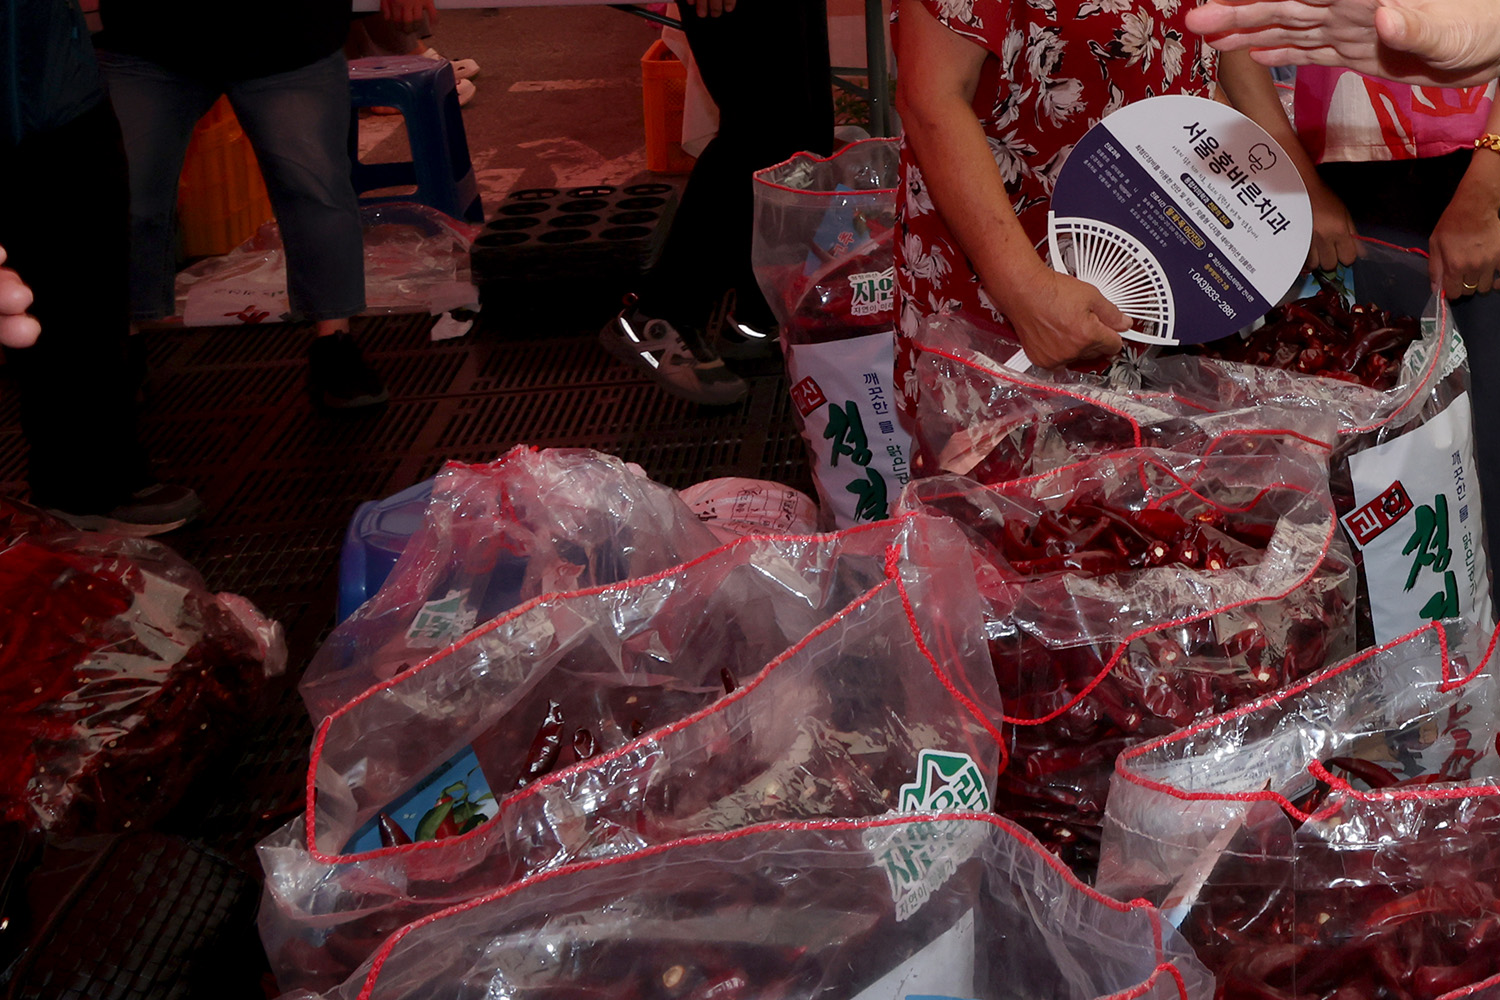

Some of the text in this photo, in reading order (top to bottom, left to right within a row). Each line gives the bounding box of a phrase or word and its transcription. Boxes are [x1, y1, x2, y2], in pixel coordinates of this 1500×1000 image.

[1183, 120, 1292, 236] 서울홍바른치과
[1170, 182, 1181, 193] 진단
[1207, 222, 1221, 237] 디지털
[1182, 225, 1203, 247] 야간진료
[1190, 271, 1236, 321] 043)833-2881
[863, 372, 889, 415] 깨끗한
